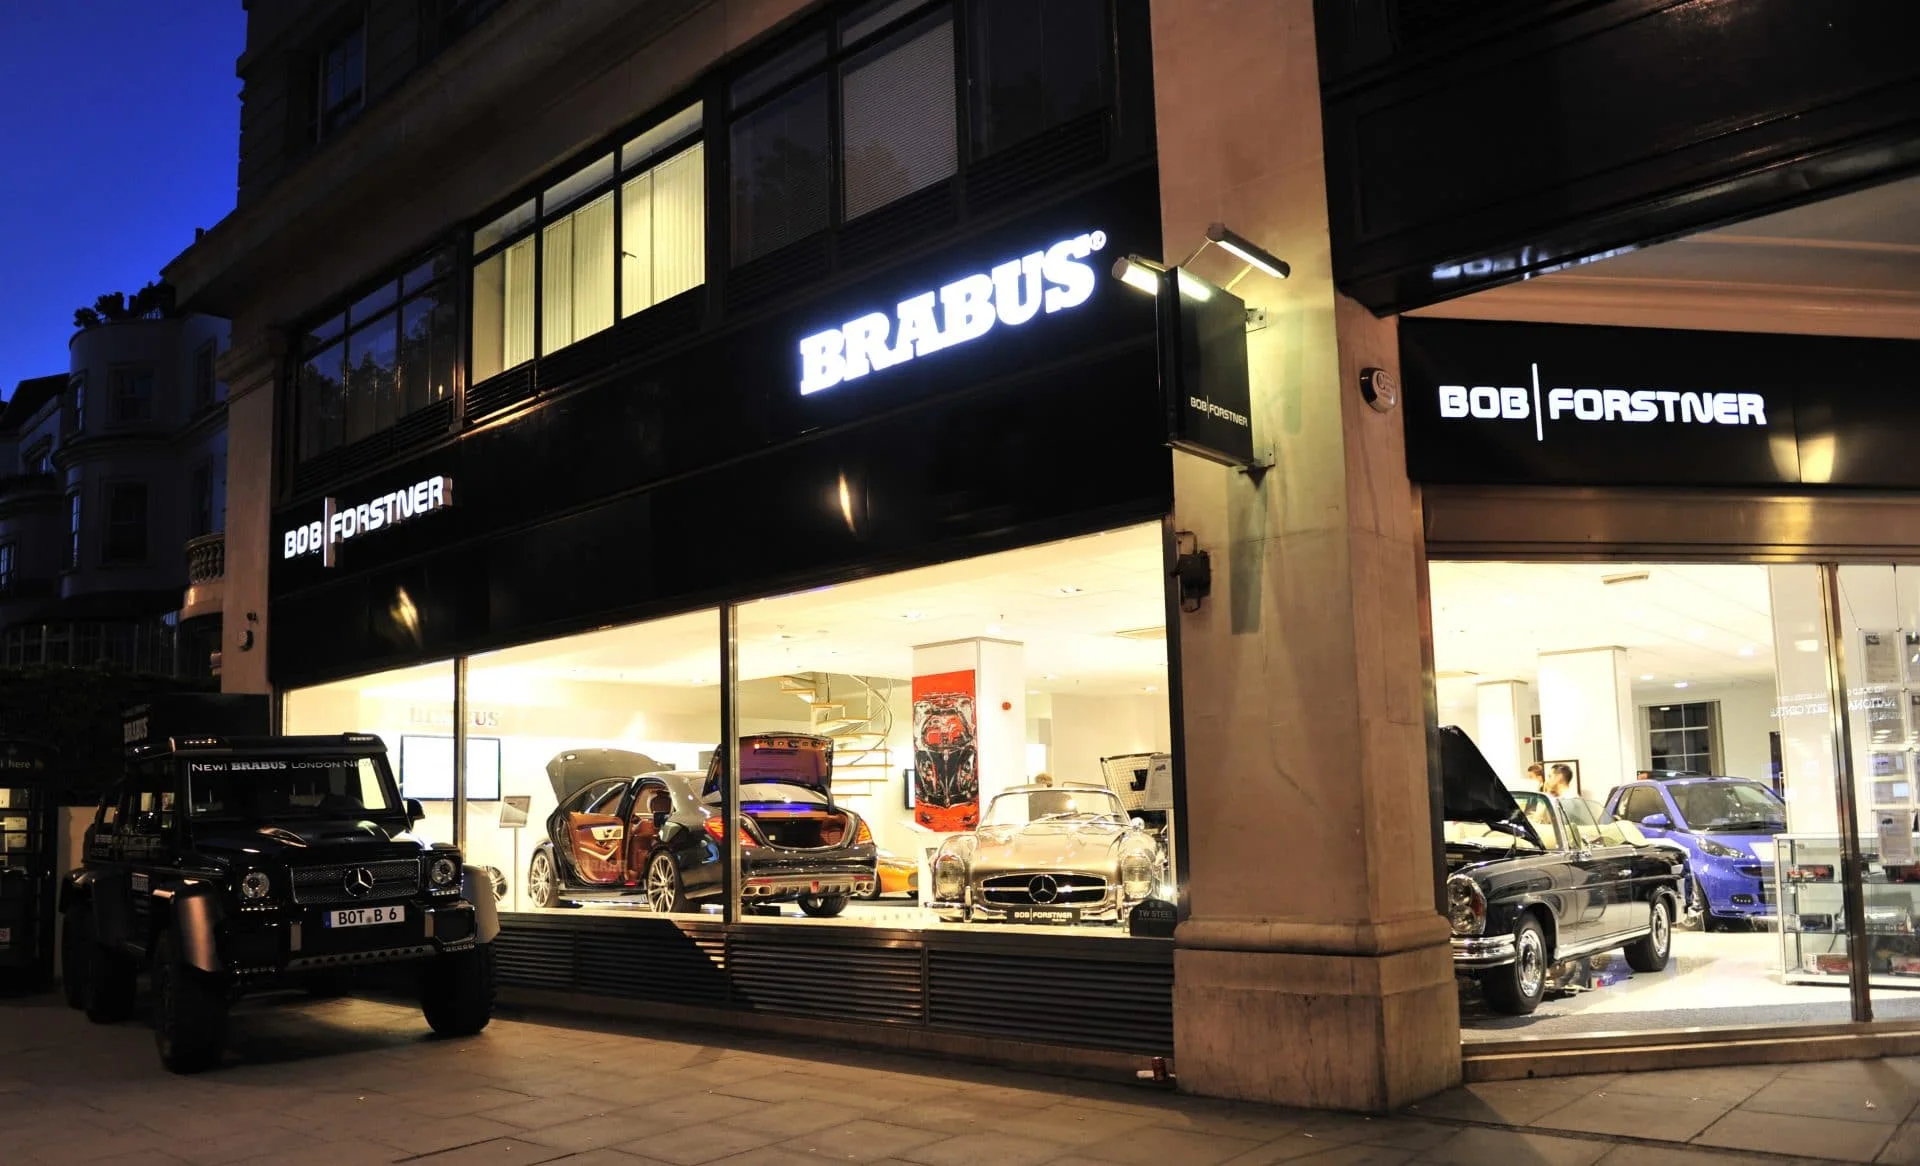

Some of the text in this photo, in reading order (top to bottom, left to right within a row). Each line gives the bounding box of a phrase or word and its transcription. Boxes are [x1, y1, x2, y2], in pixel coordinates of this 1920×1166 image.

[1190, 396, 1248, 427] BOB FORSTNER
[1438, 385, 1531, 419] BOB
[1548, 387, 1768, 425] FORSTNER
[284, 475, 446, 559] BOB FORSTNER
[231, 761, 287, 770] BRABUS
[291, 760, 341, 769] LONDON
[338, 907, 397, 925] BOT B 6
[1014, 911, 1073, 919] BOB FORSTNER
